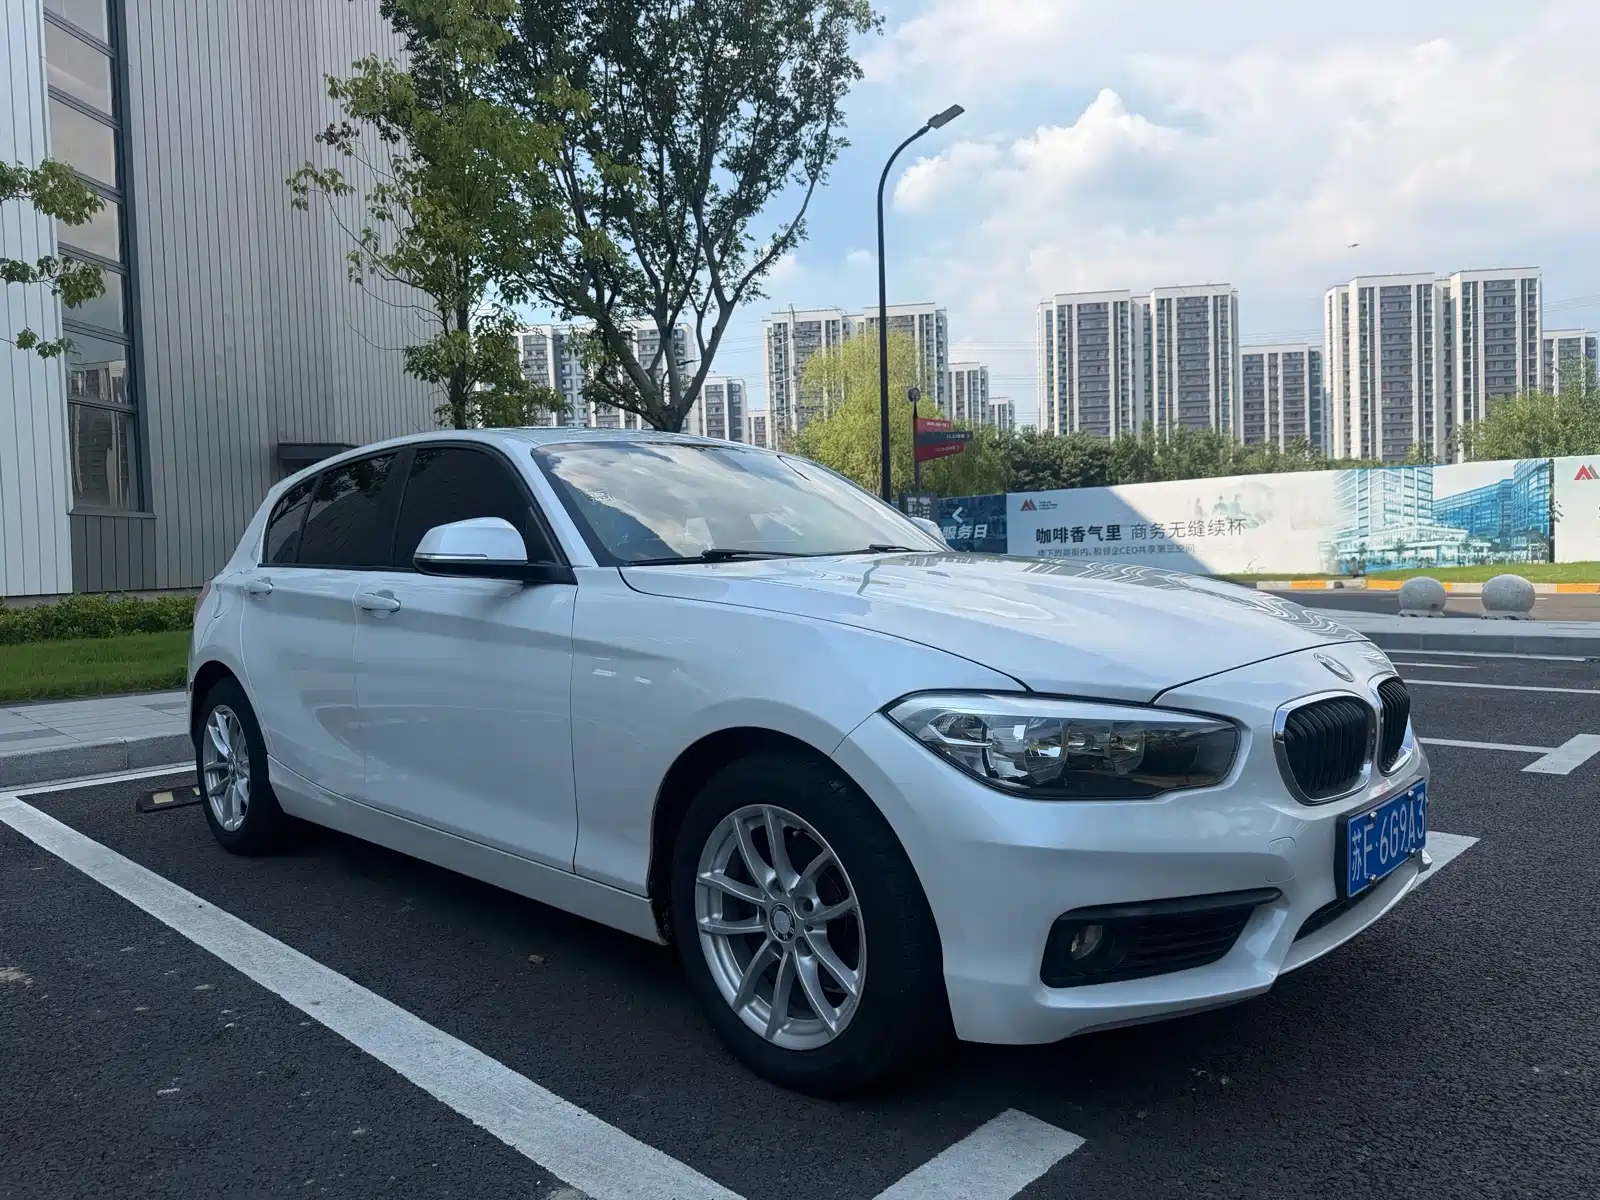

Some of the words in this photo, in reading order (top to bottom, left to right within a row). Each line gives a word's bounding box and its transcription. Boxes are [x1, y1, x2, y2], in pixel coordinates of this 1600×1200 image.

[940, 524, 988, 540] 服务日
[1036, 524, 1122, 543] 咖啡香气里
[1131, 517, 1247, 541] 商务无缝续杯
